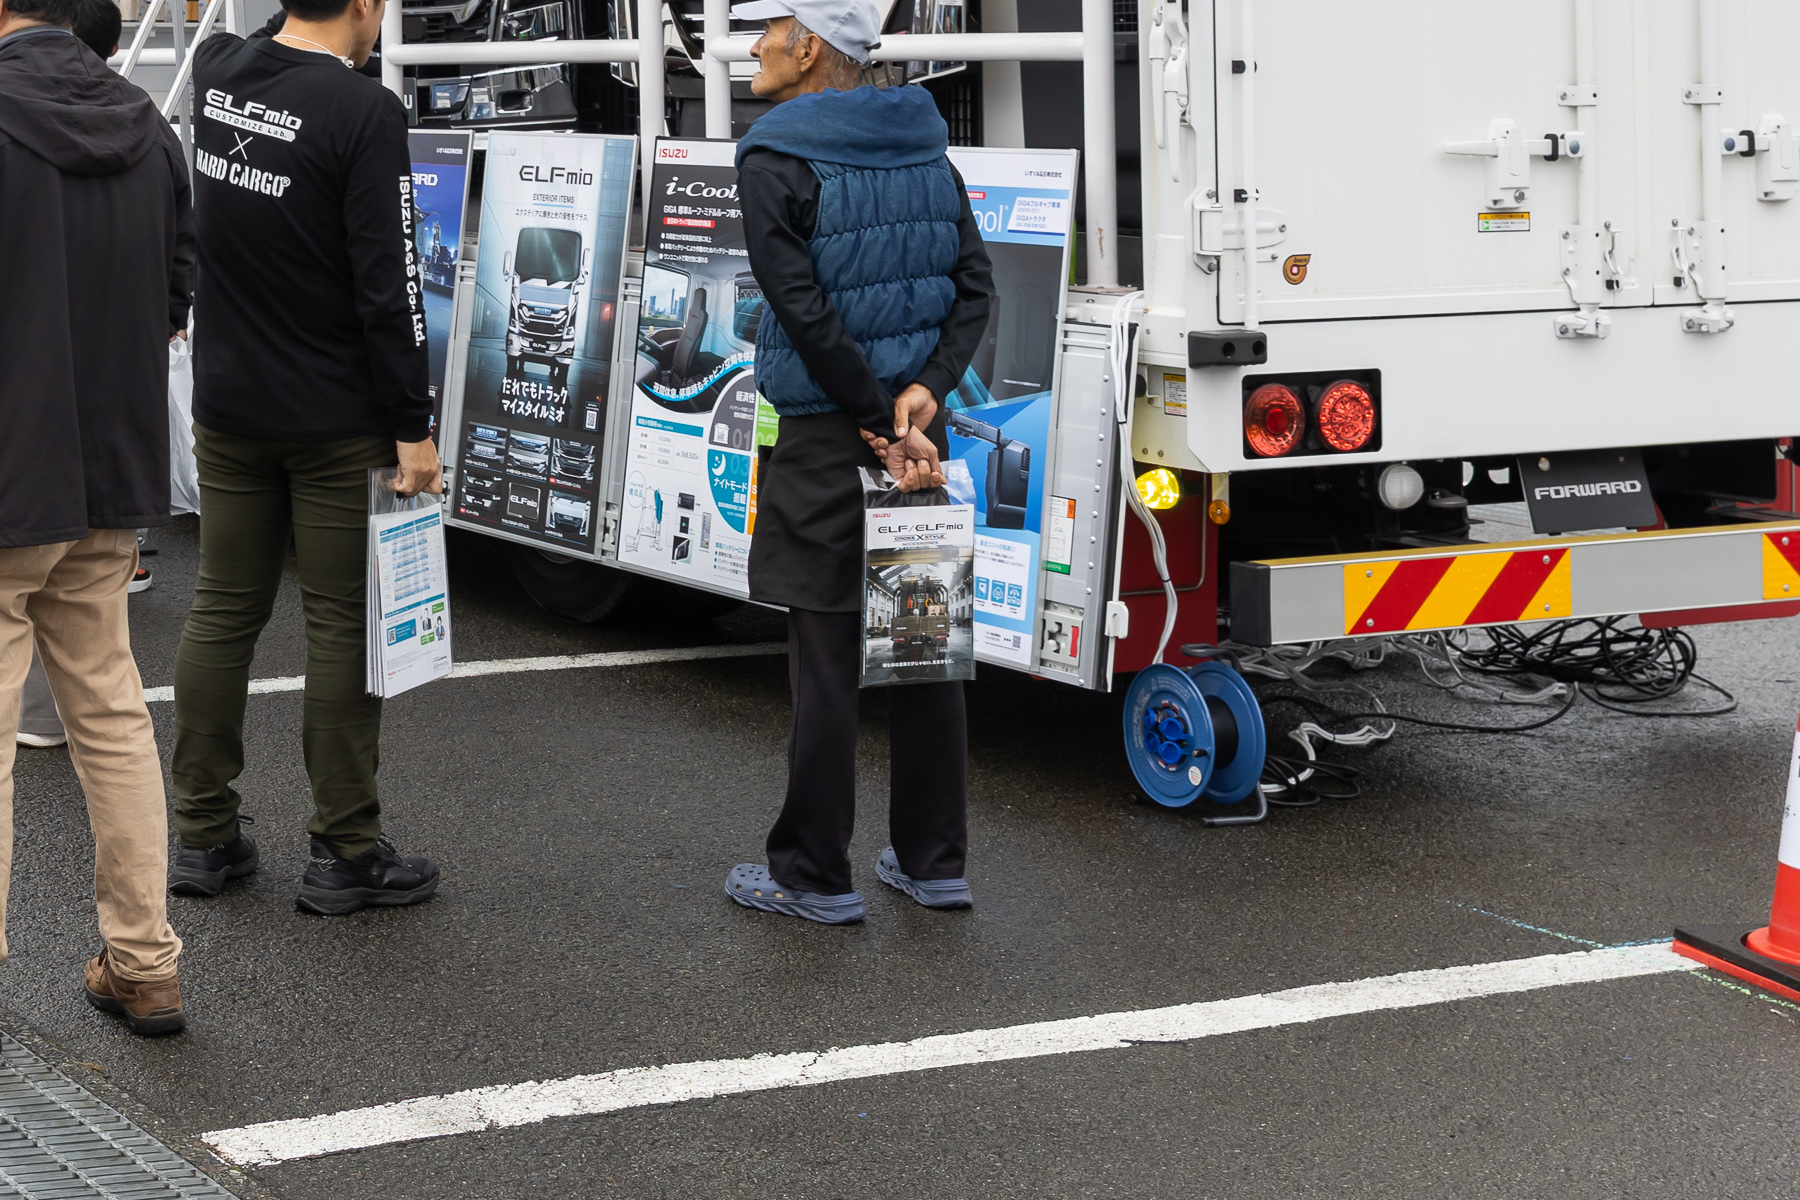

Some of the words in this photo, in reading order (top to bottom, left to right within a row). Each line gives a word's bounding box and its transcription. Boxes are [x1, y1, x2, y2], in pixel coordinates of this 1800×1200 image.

[205, 88, 302, 131] ELFmio
[209, 109, 264, 132] CUSTOMIZE
[267, 126, 287, 139] Lab.
[196, 147, 228, 181] HARD
[659, 148, 688, 158] ISUZU
[533, 193, 558, 202] EXTERIOR
[558, 195, 575, 204] ITEMS
[665, 176, 738, 199] i-Cool
[399, 175, 411, 234] ISUZU
[663, 205, 677, 214] GIGA
[972, 204, 1004, 233] ool
[404, 238, 416, 278] A&S
[411, 314, 426, 347] Ltd.
[502, 376, 568, 404] だれでもトラック
[501, 398, 565, 423] マイスタイルミオ
[713, 477, 747, 492] ナイトモード
[1534, 480, 1641, 500] FORWARD
